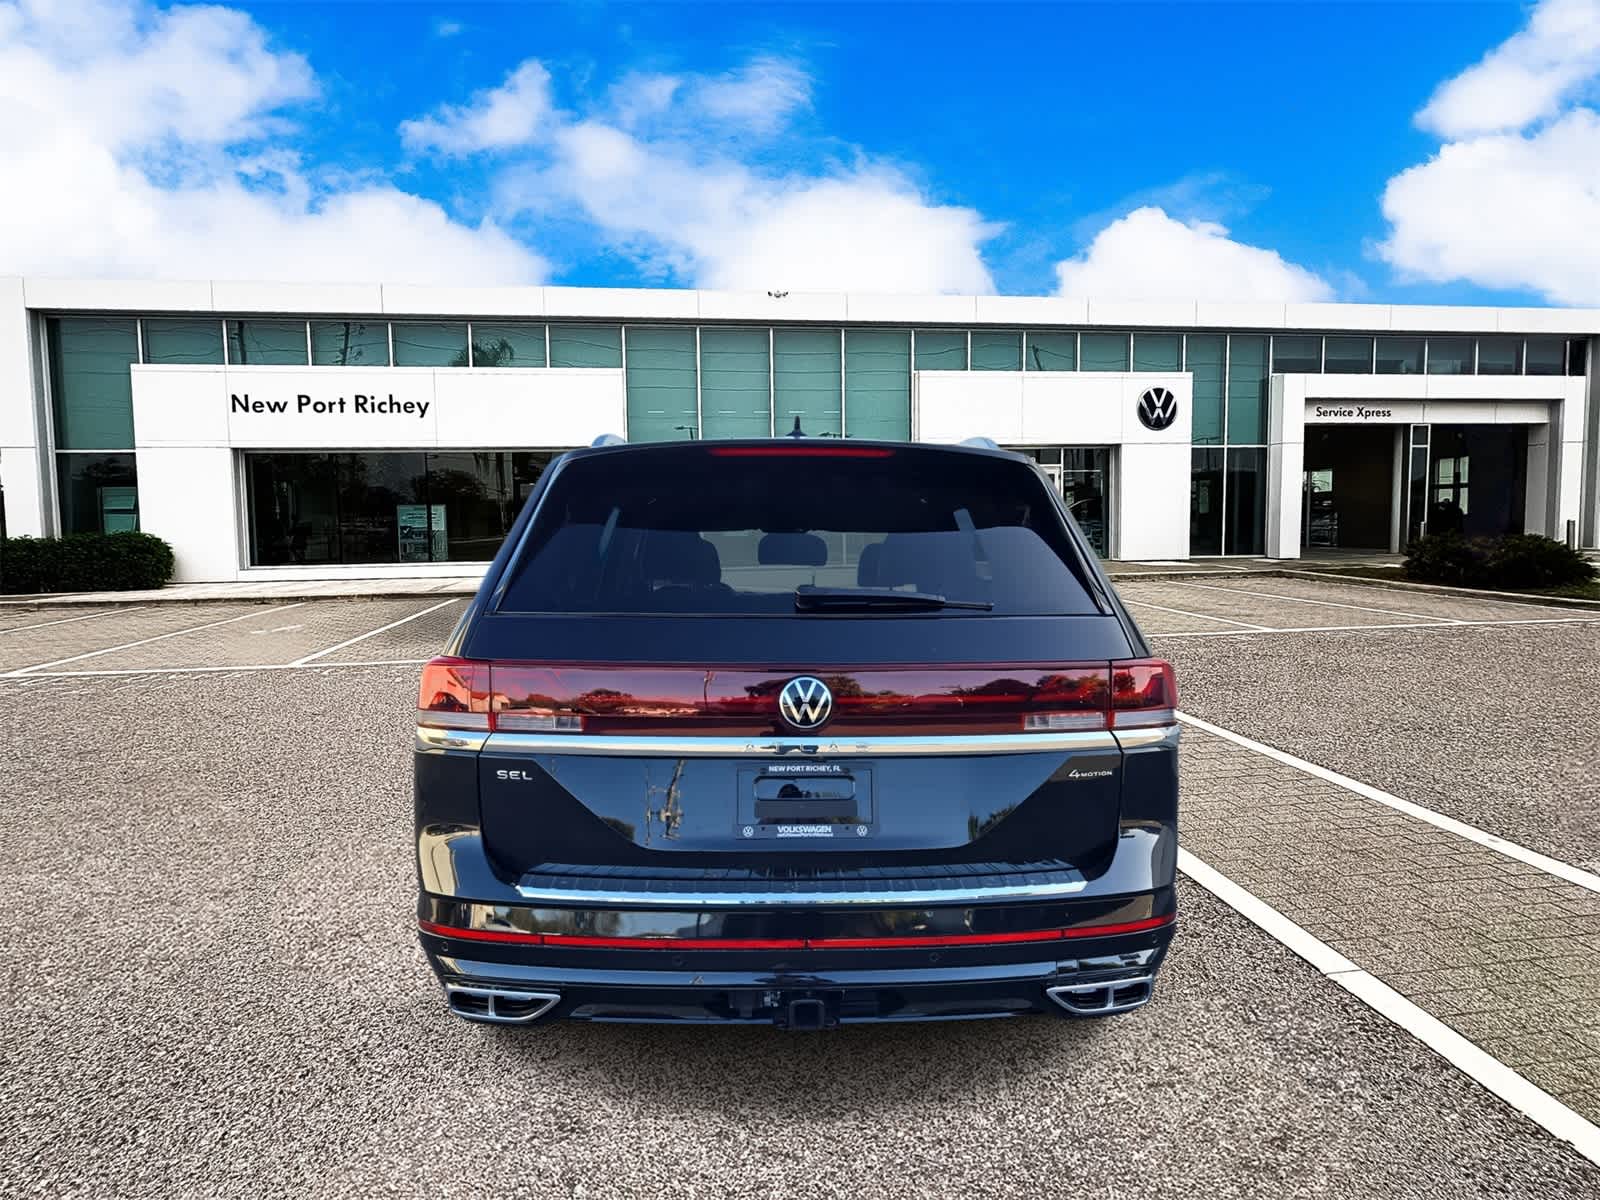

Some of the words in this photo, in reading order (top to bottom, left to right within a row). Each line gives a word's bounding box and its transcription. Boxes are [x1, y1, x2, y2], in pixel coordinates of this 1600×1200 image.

[231, 394, 288, 413] New
[297, 394, 346, 413] Port
[354, 394, 430, 418] Richey
[1315, 406, 1354, 418] Service
[1356, 406, 1392, 419] Xpress
[496, 770, 533, 780] SEL
[1069, 769, 1112, 778] 4MOTION
[777, 825, 832, 833] VOLKSWAGEN
